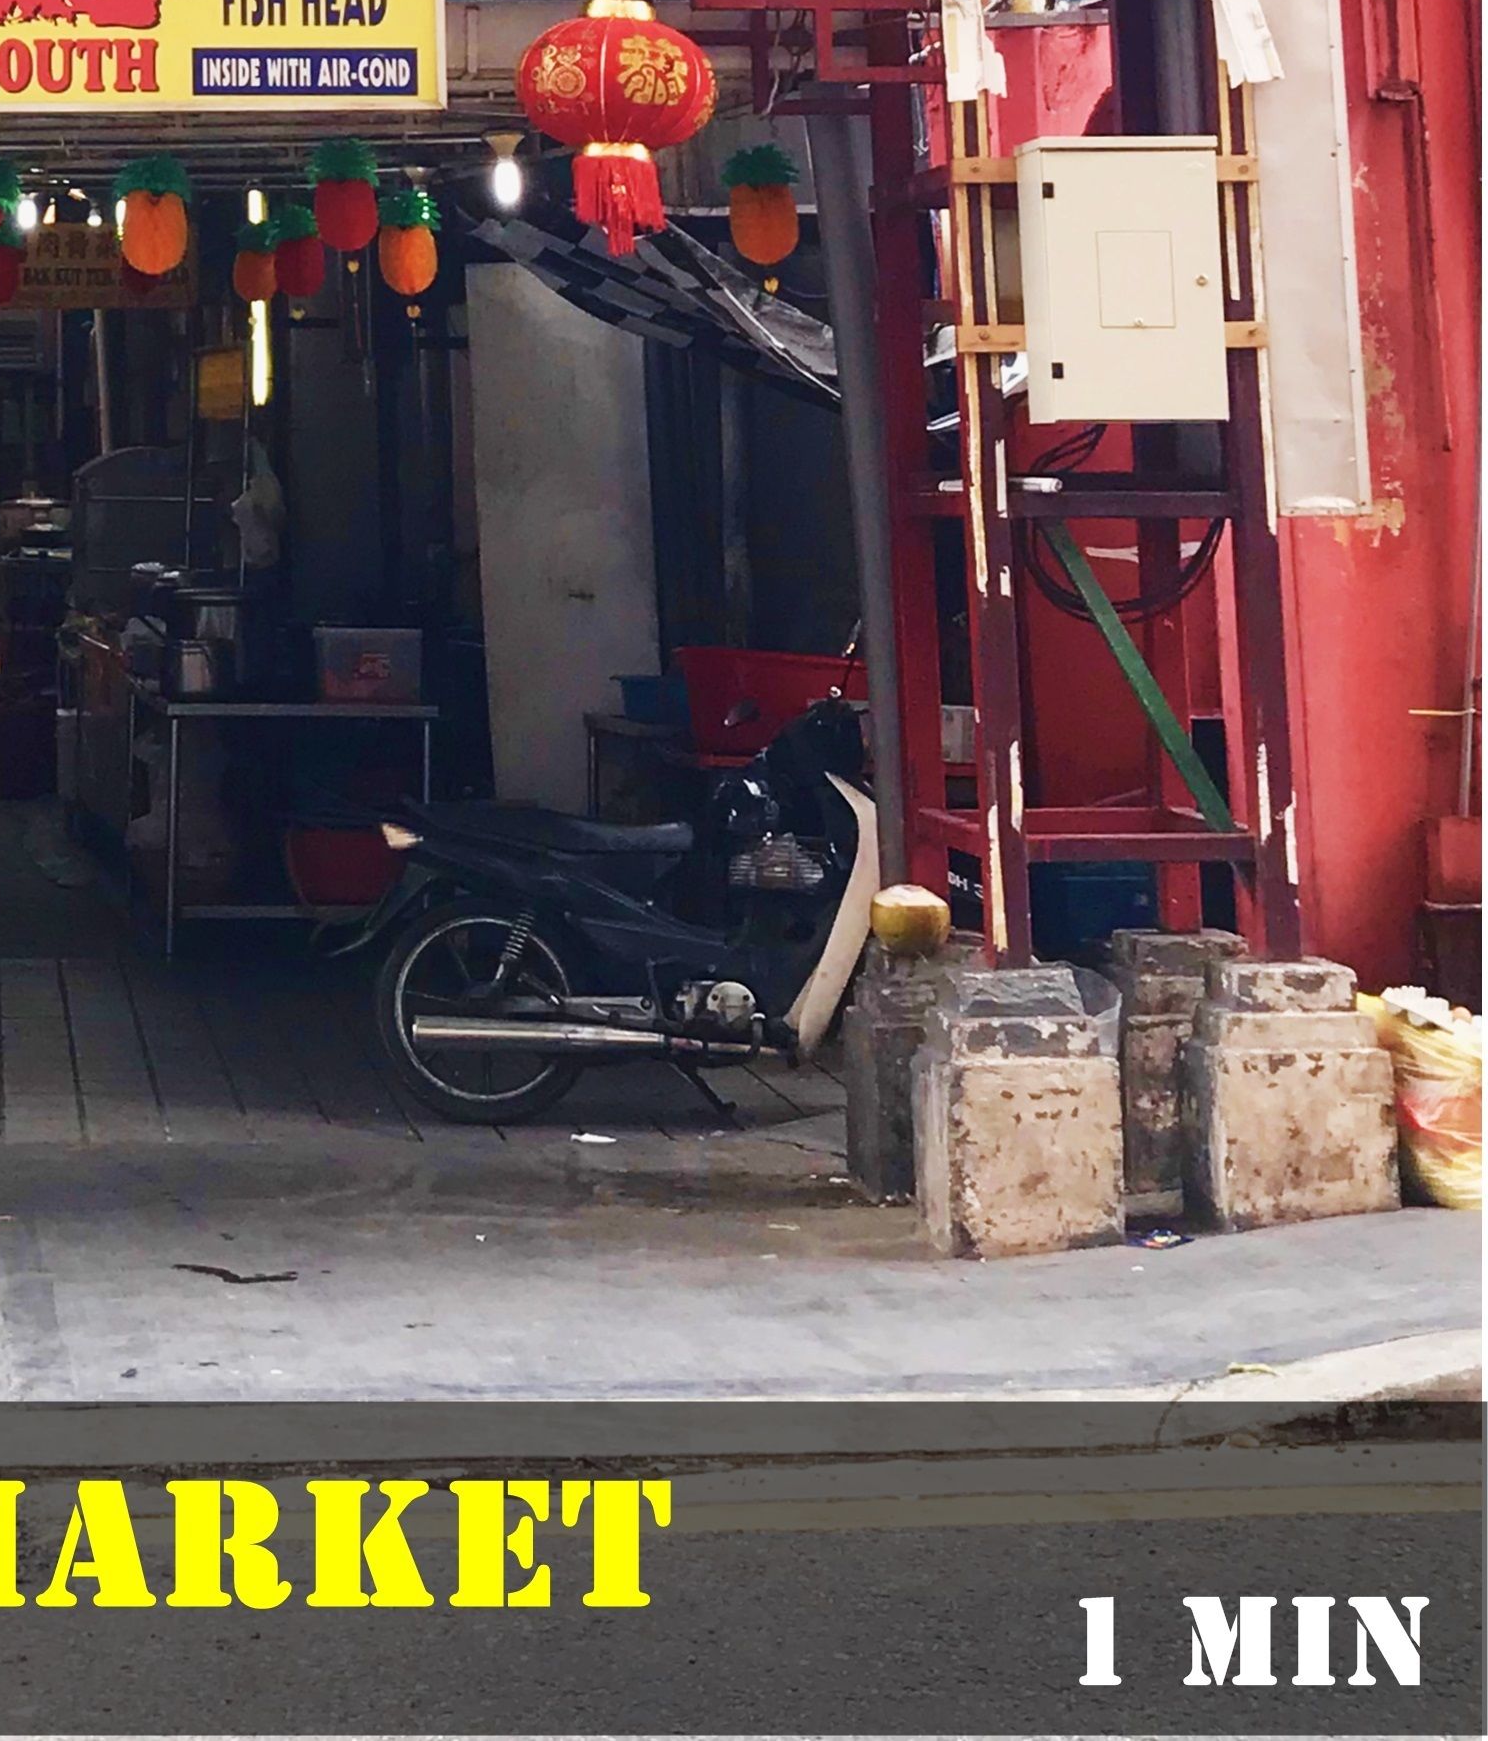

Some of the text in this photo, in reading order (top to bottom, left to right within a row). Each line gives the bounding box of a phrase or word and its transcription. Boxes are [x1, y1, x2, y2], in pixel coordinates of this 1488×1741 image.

[201, 57, 411, 88] INSIDE WITH AIR-COND
